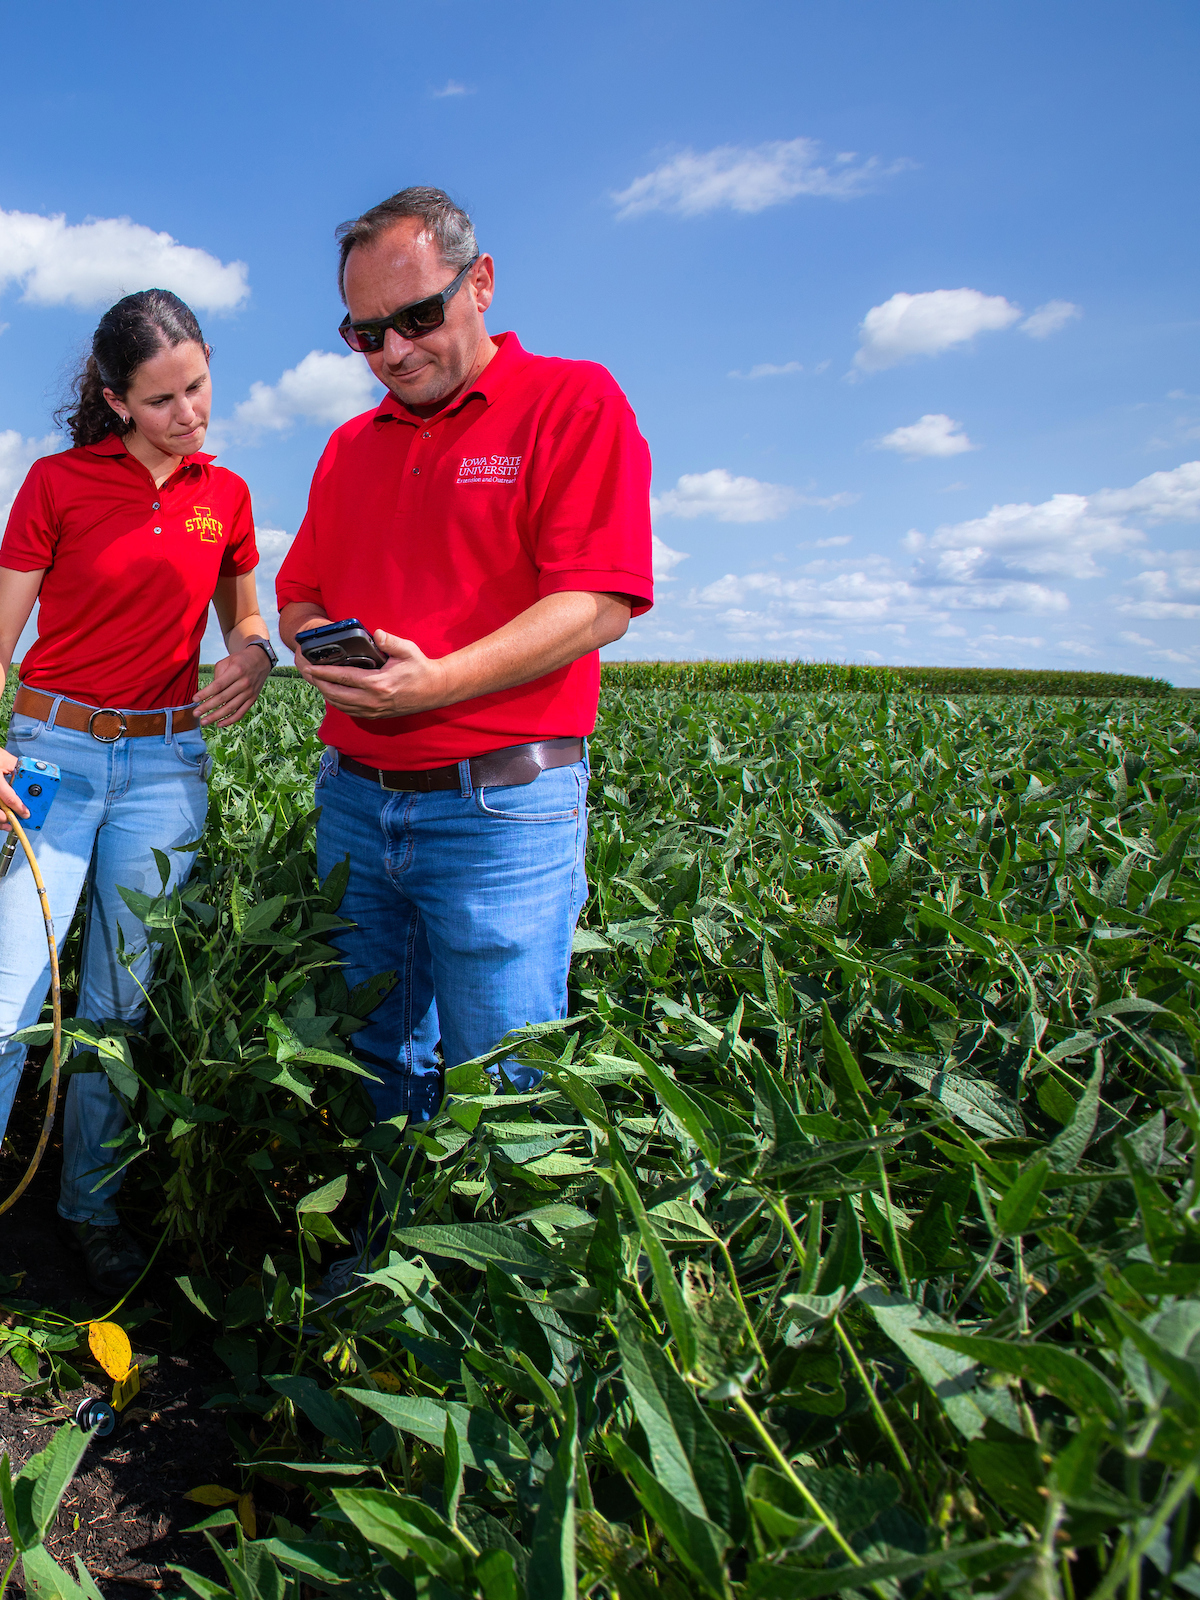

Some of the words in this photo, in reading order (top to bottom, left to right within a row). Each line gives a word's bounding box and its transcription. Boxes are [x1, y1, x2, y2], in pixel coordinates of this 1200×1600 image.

[461, 457, 488, 467] IOWA
[489, 454, 522, 466] STATE
[458, 465, 520, 476] UNIVERSITY
[185, 517, 223, 537] STATE
